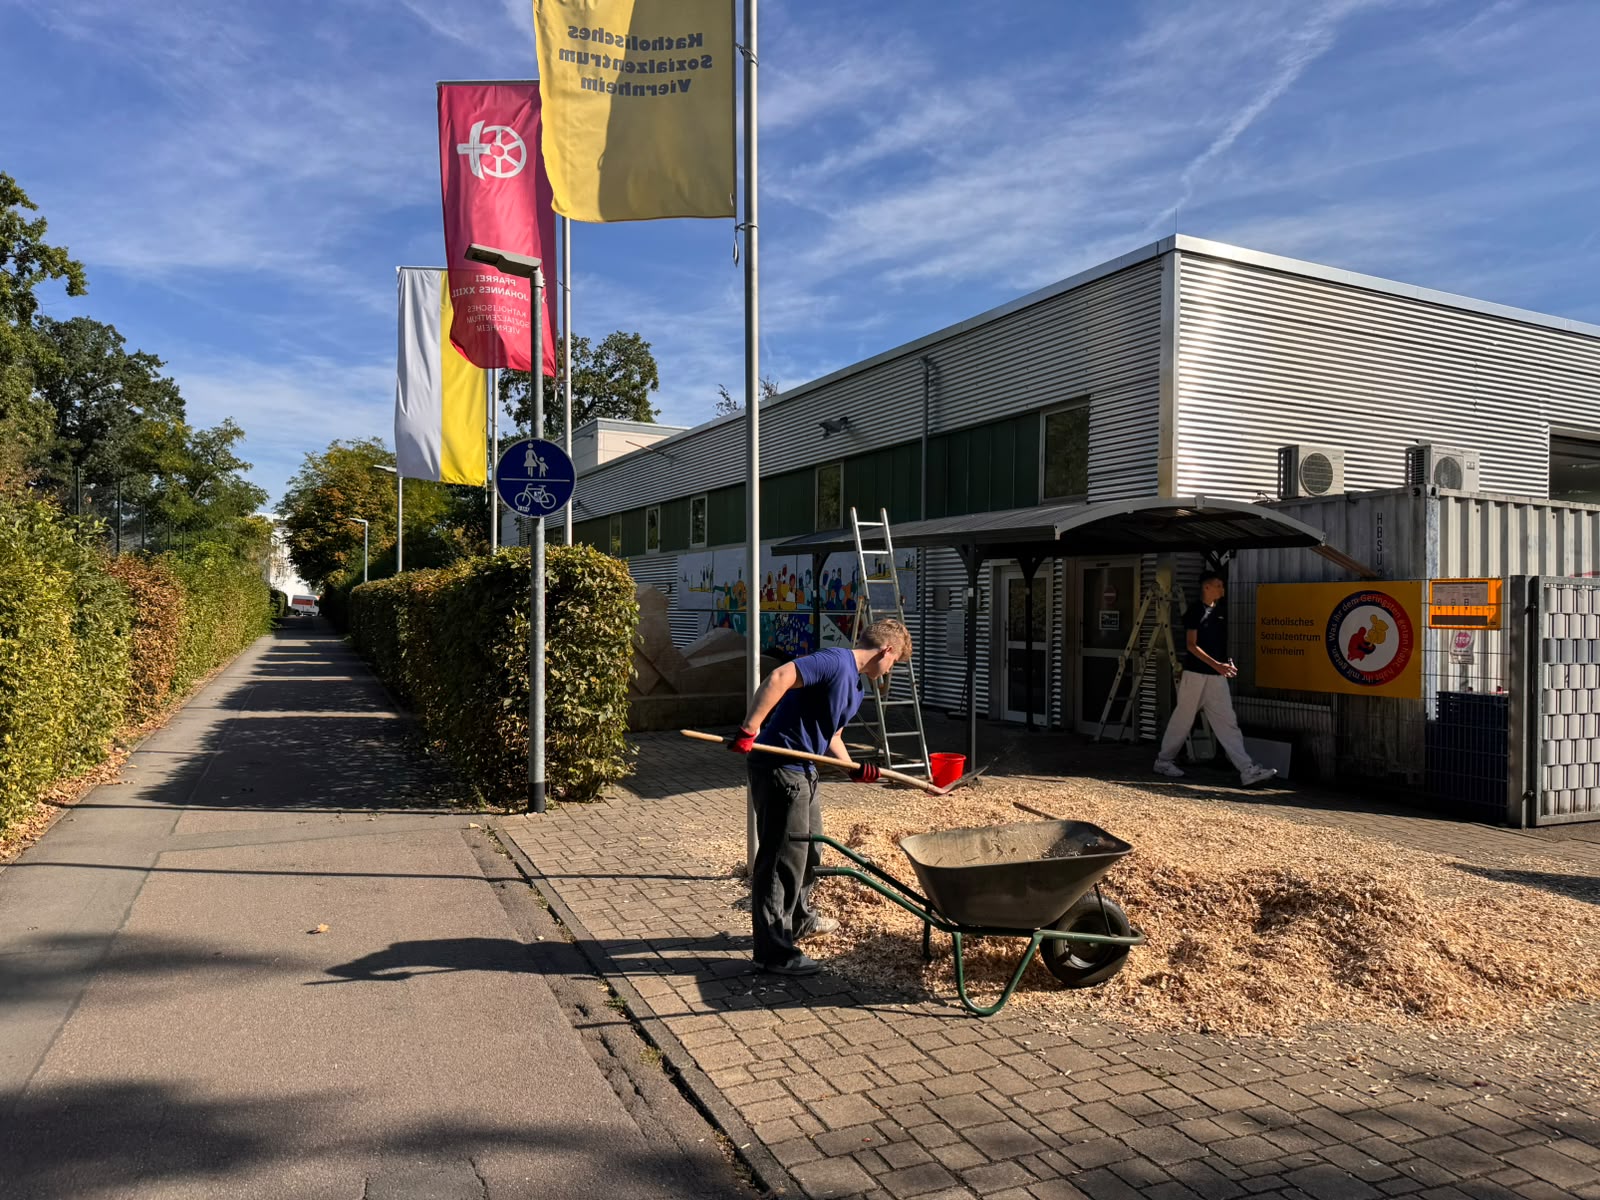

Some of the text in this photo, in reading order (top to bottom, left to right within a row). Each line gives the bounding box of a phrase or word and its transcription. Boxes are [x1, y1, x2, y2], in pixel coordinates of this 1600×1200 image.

[1260, 616, 1315, 626] Katholisches
[1328, 622, 1337, 641] Was
[1334, 610, 1344, 623] ihr
[1342, 596, 1360, 612] dem
[1360, 594, 1401, 619] Geringsten
[1260, 631, 1321, 642] Sozialzentrum
[1260, 646, 1305, 656] Viernheim
